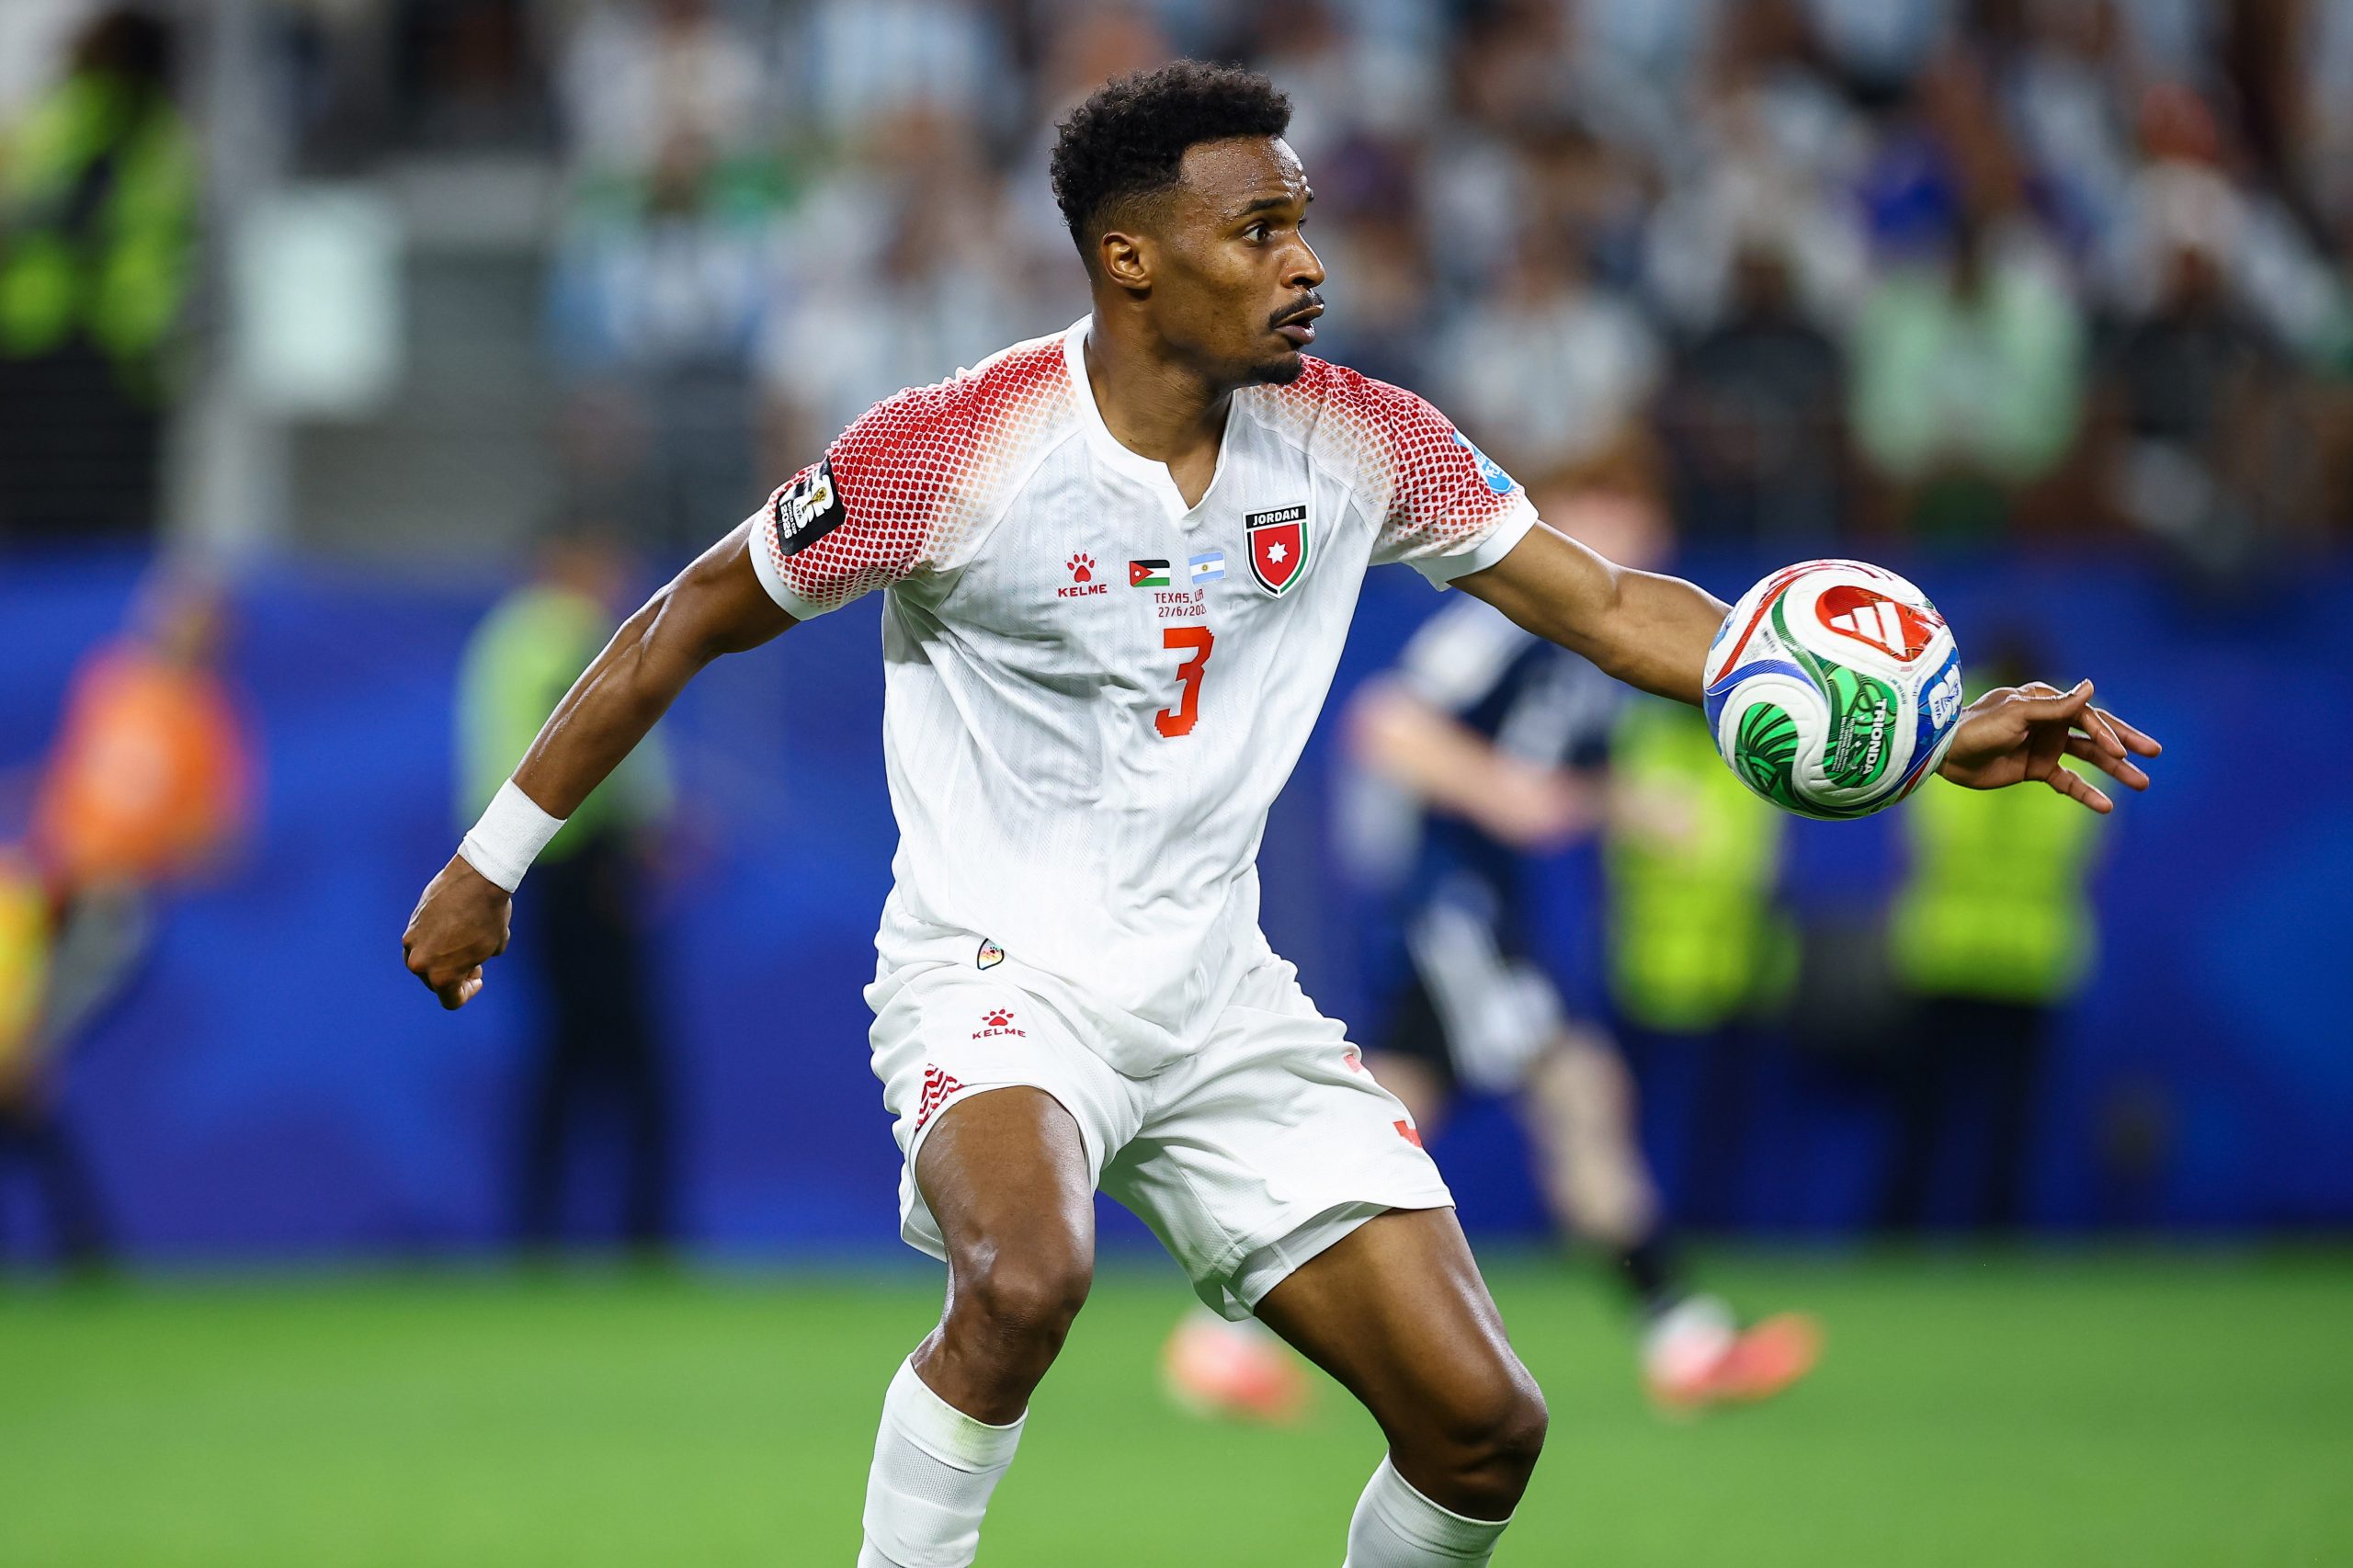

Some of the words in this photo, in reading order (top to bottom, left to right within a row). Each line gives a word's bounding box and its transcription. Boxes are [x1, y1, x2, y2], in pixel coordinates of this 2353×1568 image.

[780, 505, 792, 539] 2026
[1253, 508, 1299, 526] JORDAN
[1058, 584, 1108, 597] KELME
[1154, 592, 1193, 604] TEXAS,
[1158, 603, 1207, 618] 27/6/202
[1154, 625, 1214, 738] 3
[1934, 700, 1942, 720] FIFA
[1862, 698, 1888, 775] TRIONDA
[972, 1028, 1026, 1040] KELME
